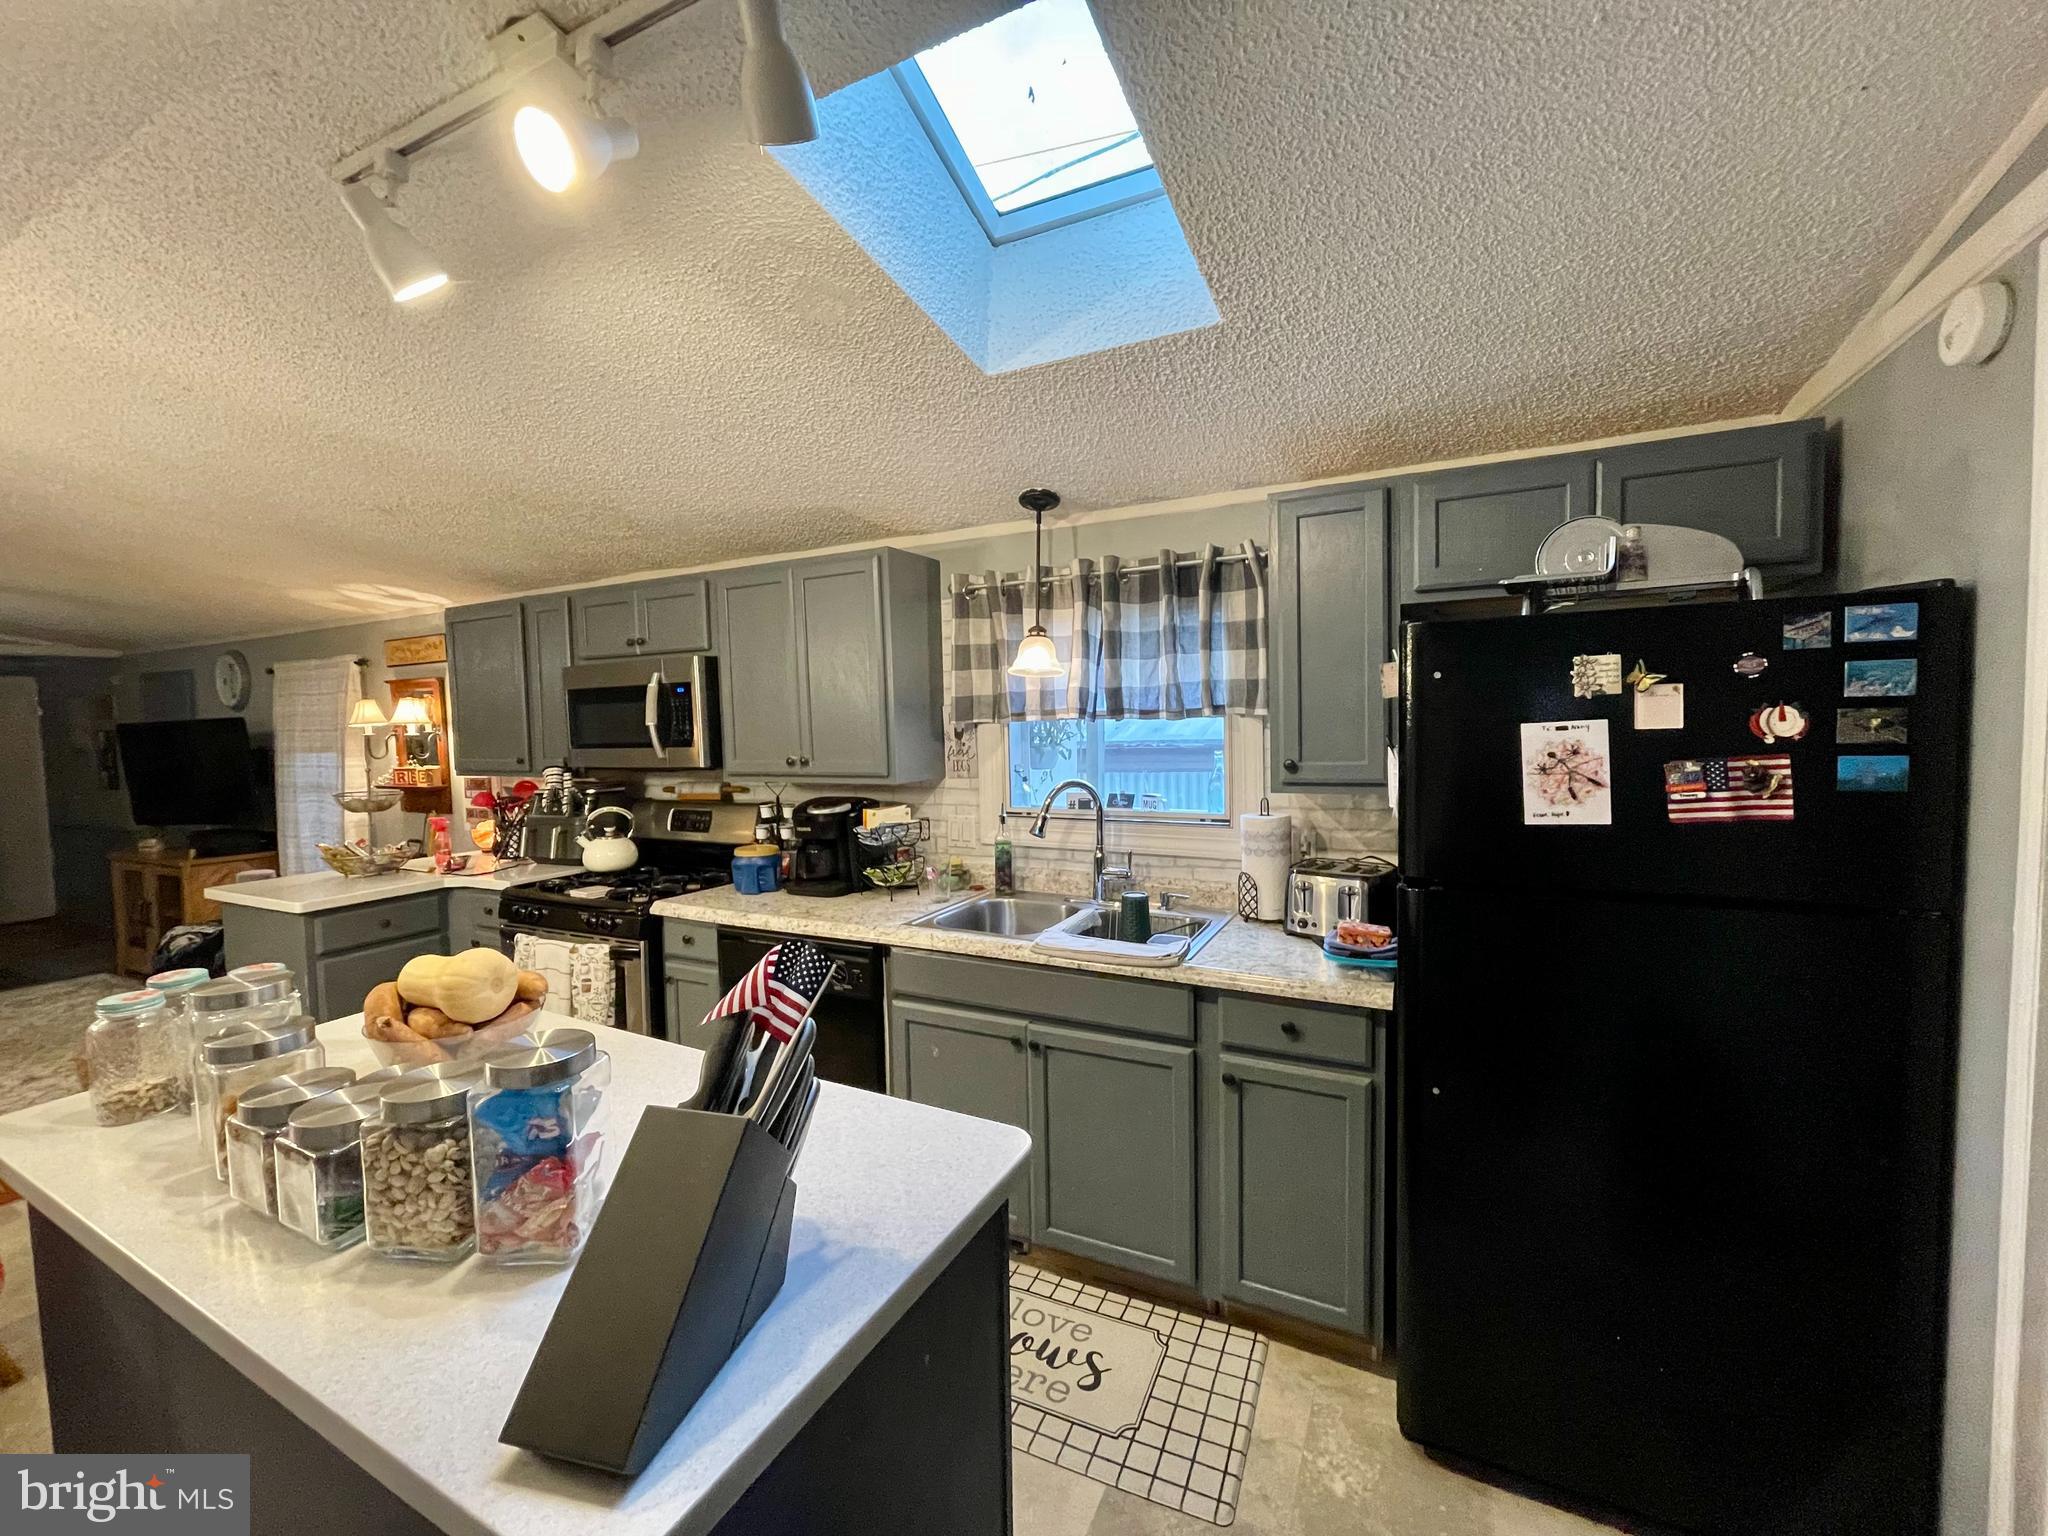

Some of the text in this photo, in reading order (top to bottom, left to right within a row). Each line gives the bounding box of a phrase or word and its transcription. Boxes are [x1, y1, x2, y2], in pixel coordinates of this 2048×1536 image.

[1010, 1296, 1093, 1342] love
[1010, 1331, 1113, 1392] ows
[1010, 1364, 1071, 1404] ere
